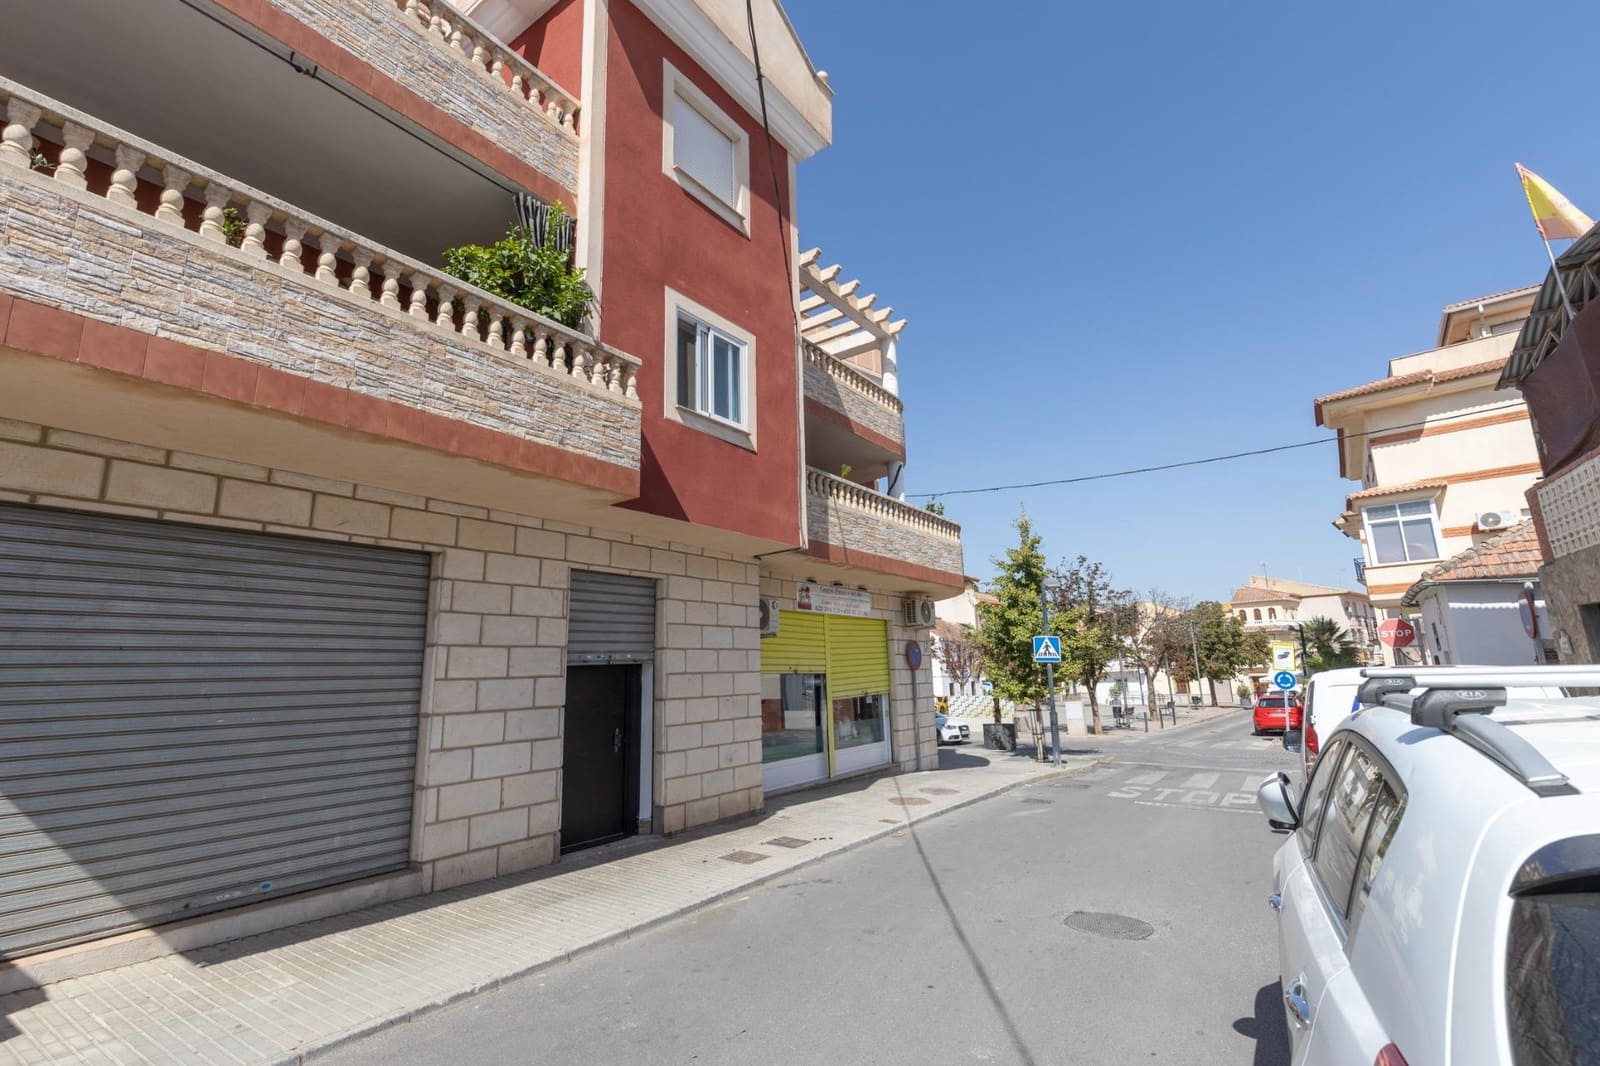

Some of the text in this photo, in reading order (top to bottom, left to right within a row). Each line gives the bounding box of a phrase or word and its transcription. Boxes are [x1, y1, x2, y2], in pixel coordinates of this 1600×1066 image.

[1381, 629, 1412, 638] STOP
[1461, 690, 1483, 698] KIA
[1107, 786, 1258, 807] STOP
